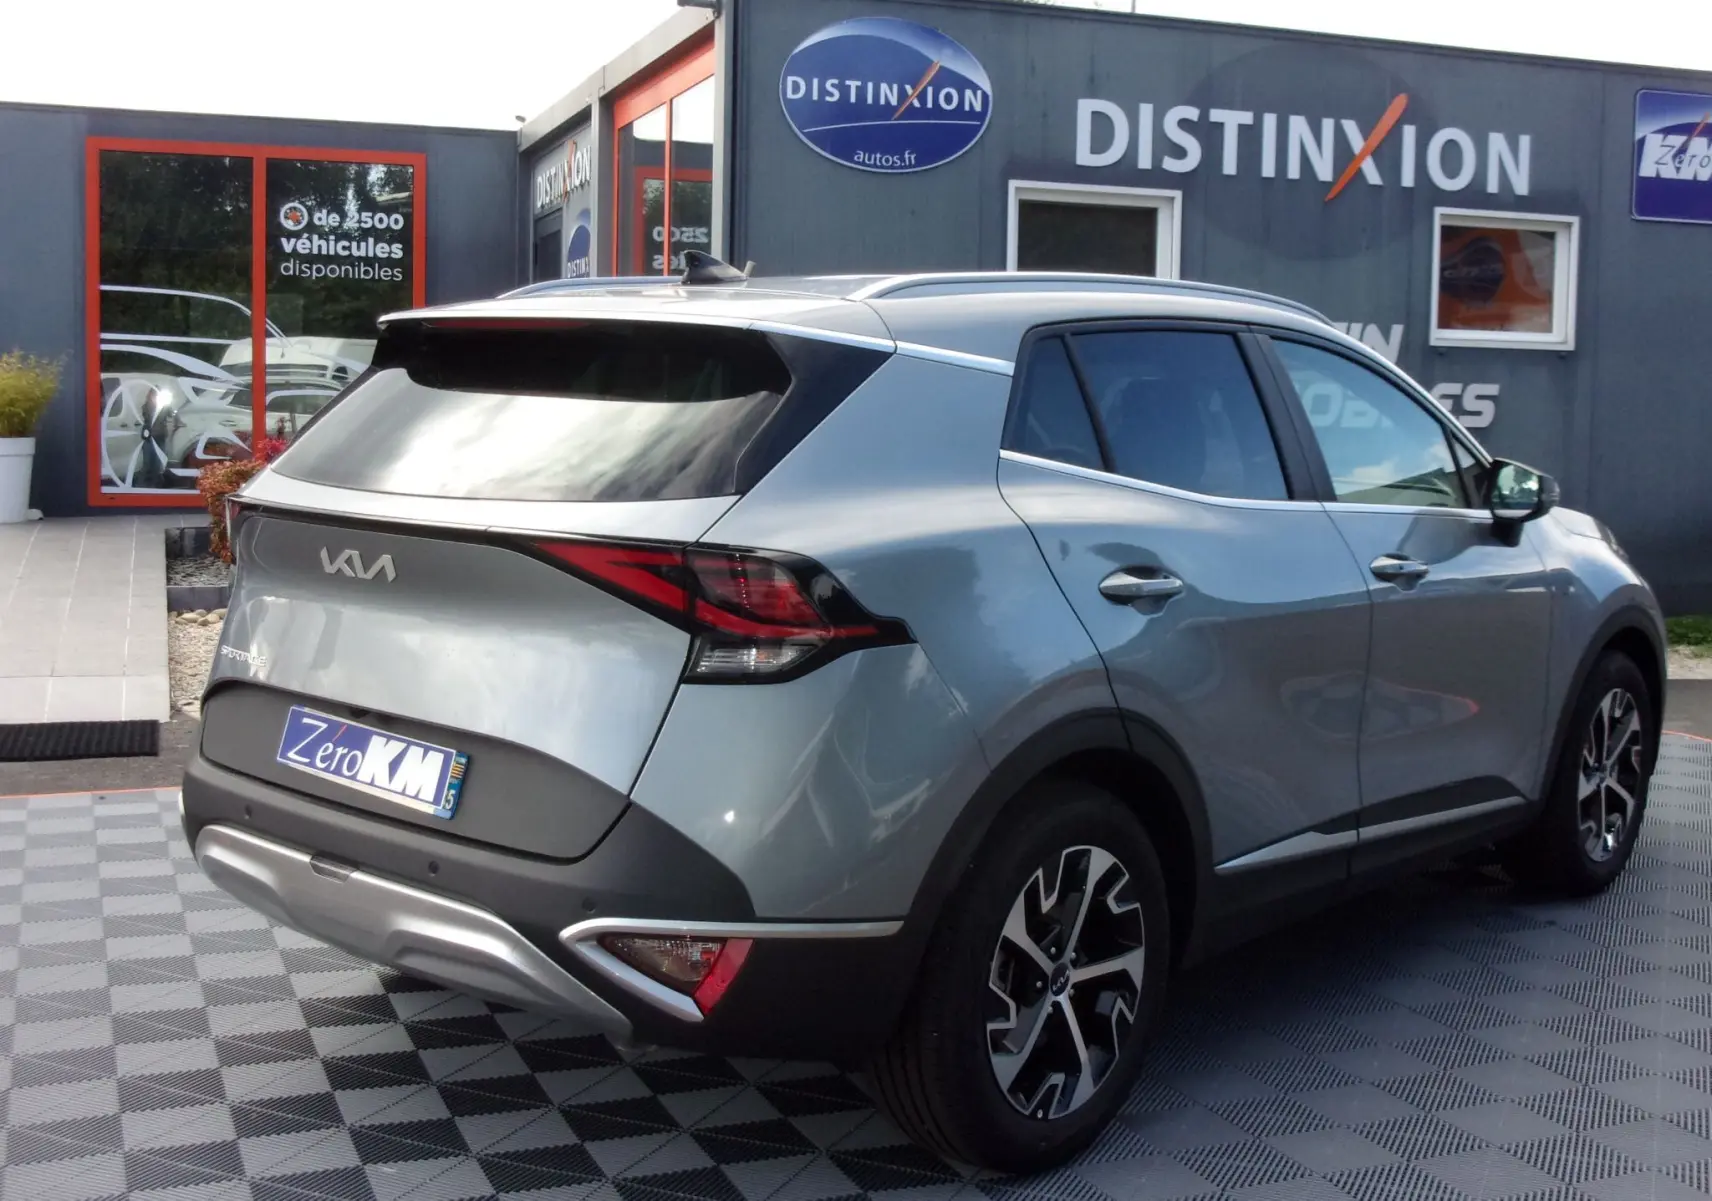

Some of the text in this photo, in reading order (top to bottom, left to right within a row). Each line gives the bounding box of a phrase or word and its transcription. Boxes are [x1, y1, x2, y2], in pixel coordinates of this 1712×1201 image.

[786, 61, 982, 120] DISTINXION
[853, 150, 917, 167] autos.fr
[1075, 94, 1531, 202] DISTINXION
[313, 209, 405, 230] de 2500
[281, 232, 404, 259] véhicules
[280, 258, 403, 281] disponibles
[319, 546, 397, 583] KIA
